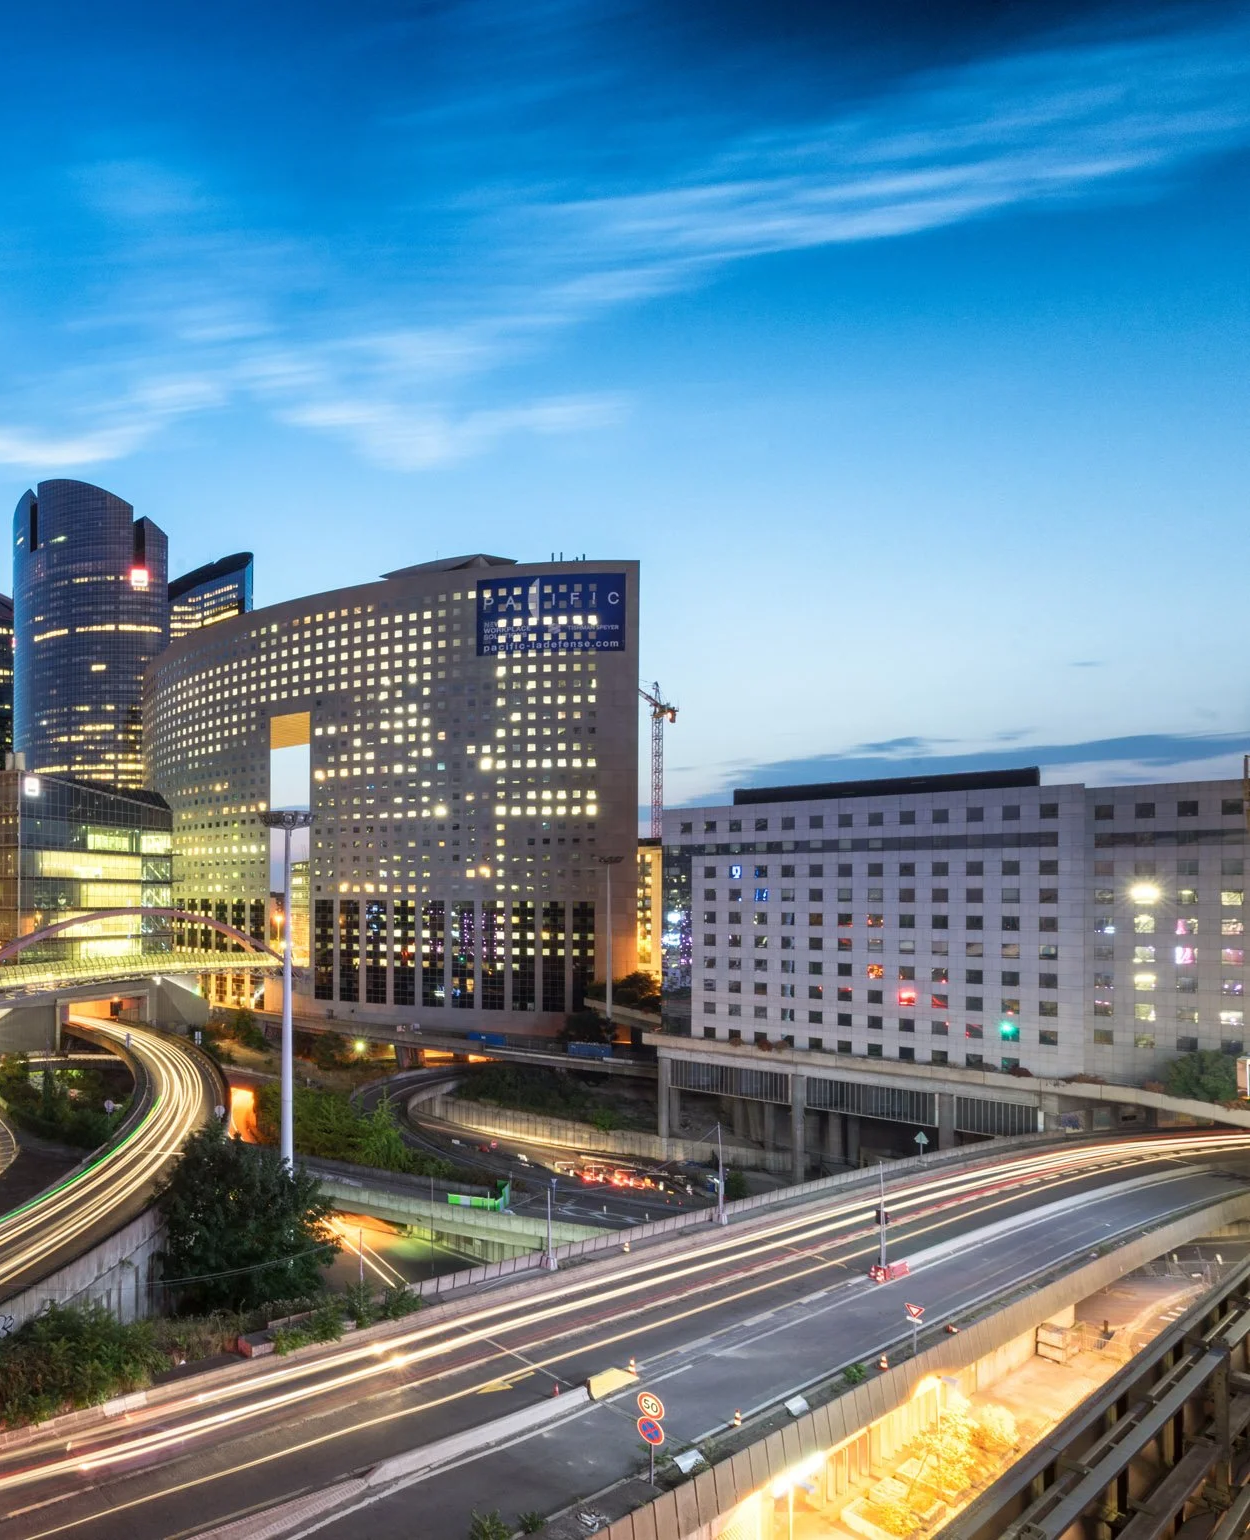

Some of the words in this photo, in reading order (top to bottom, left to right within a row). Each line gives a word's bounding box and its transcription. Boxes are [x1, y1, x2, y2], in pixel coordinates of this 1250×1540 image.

[484, 625, 531, 634] WORKPLACE
[483, 640, 619, 654] pacific-ladefense.com
[643, 1398, 658, 1413] 50
